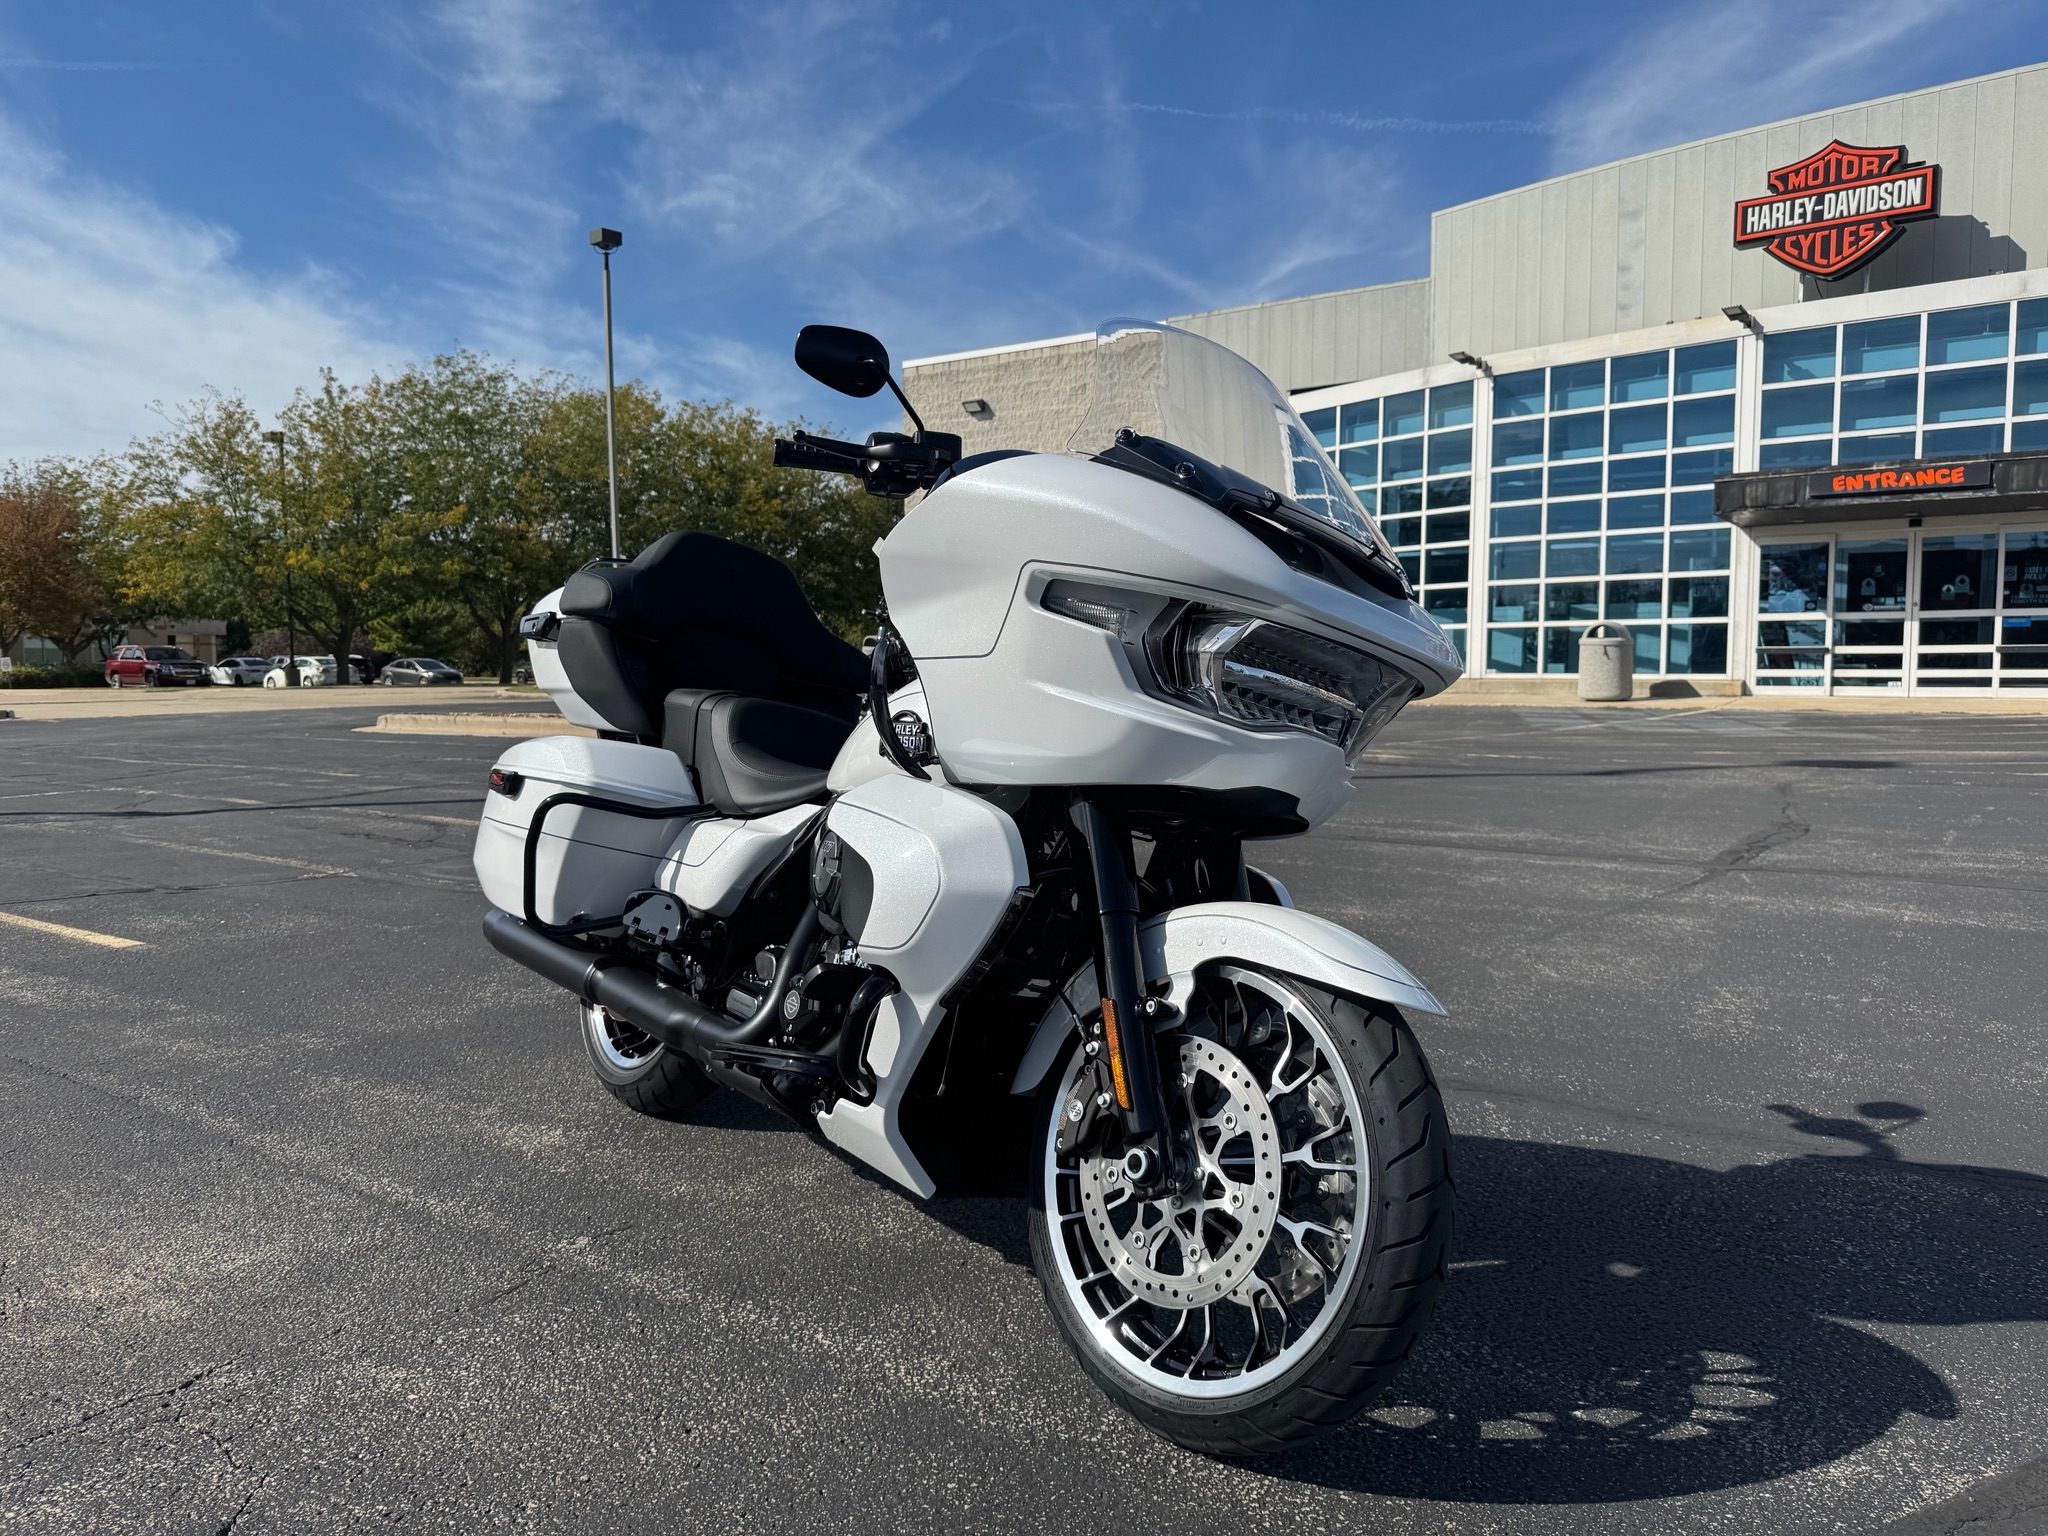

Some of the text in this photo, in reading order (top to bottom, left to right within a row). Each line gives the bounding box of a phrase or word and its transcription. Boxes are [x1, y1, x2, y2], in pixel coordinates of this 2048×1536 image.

[1788, 152, 1880, 191] MOTOR
[1746, 177, 1923, 234] HARLEY-DAVIDSON
[1785, 223, 1875, 265] CYCLES
[1832, 466, 1965, 491] ENTRANCE
